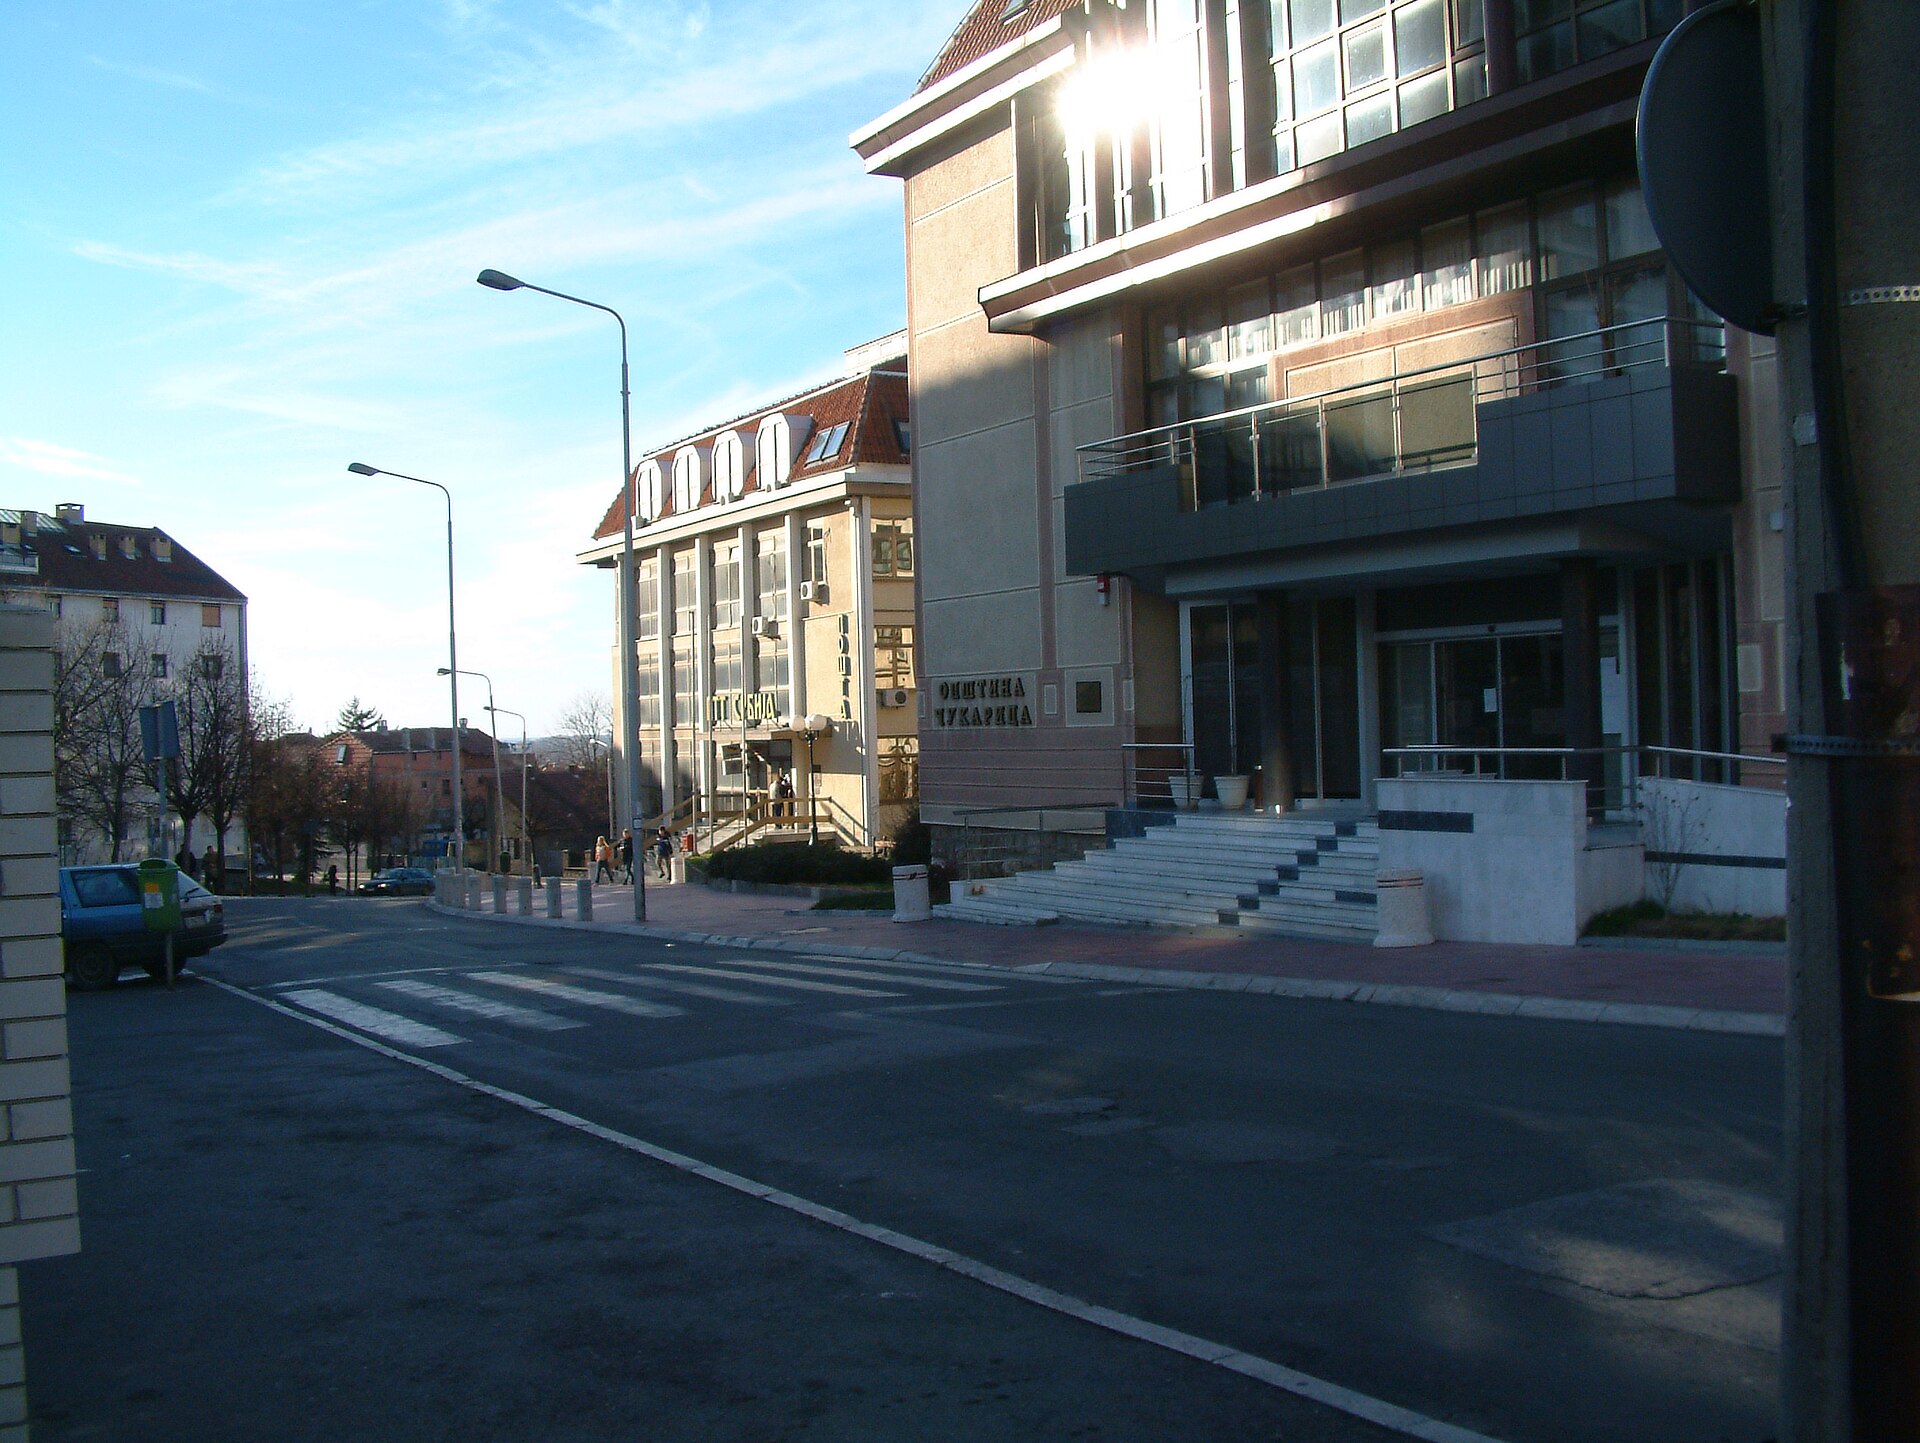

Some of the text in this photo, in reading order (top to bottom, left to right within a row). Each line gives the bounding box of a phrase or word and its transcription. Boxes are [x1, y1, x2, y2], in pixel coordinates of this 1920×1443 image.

[940, 677, 1025, 700] ОПШТИНА
[732, 692, 776, 720] СБИЈА
[935, 705, 1032, 727] ЧУКАРИЦА
